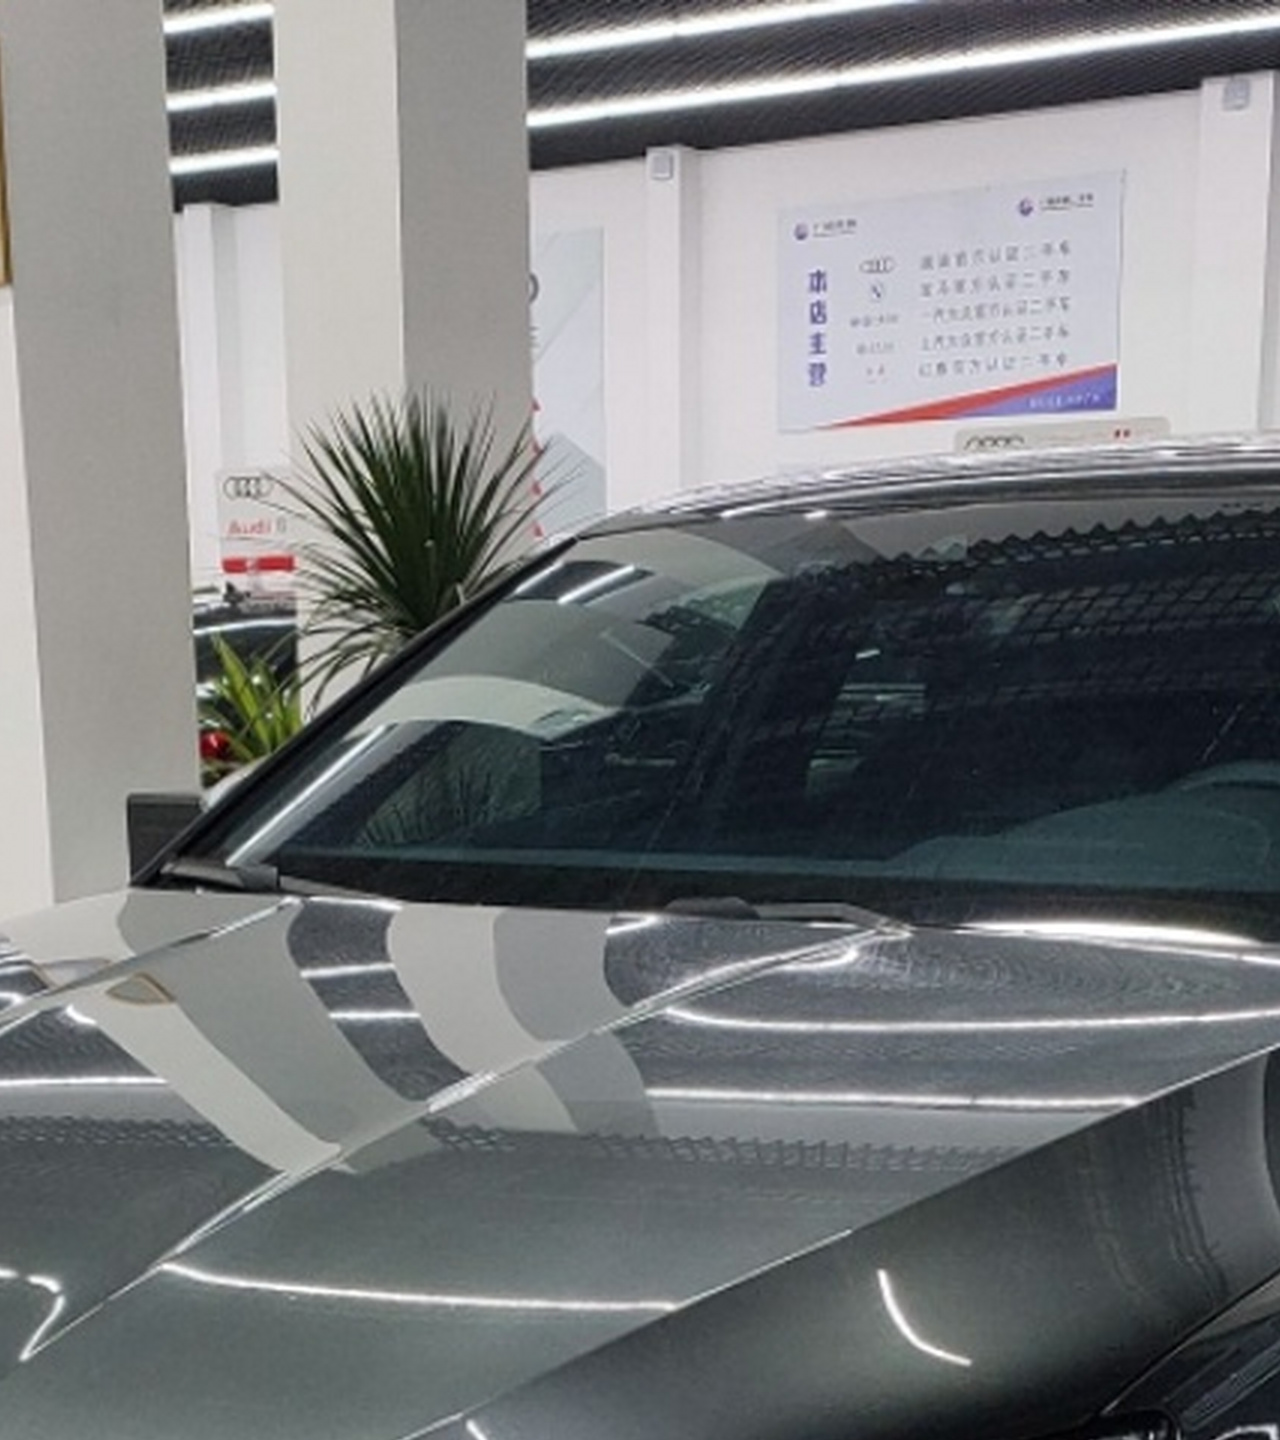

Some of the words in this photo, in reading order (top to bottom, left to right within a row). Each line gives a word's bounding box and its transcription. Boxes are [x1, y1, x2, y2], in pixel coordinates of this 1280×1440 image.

[808, 269, 828, 387] 本店主营
[229, 518, 271, 534] Audi
